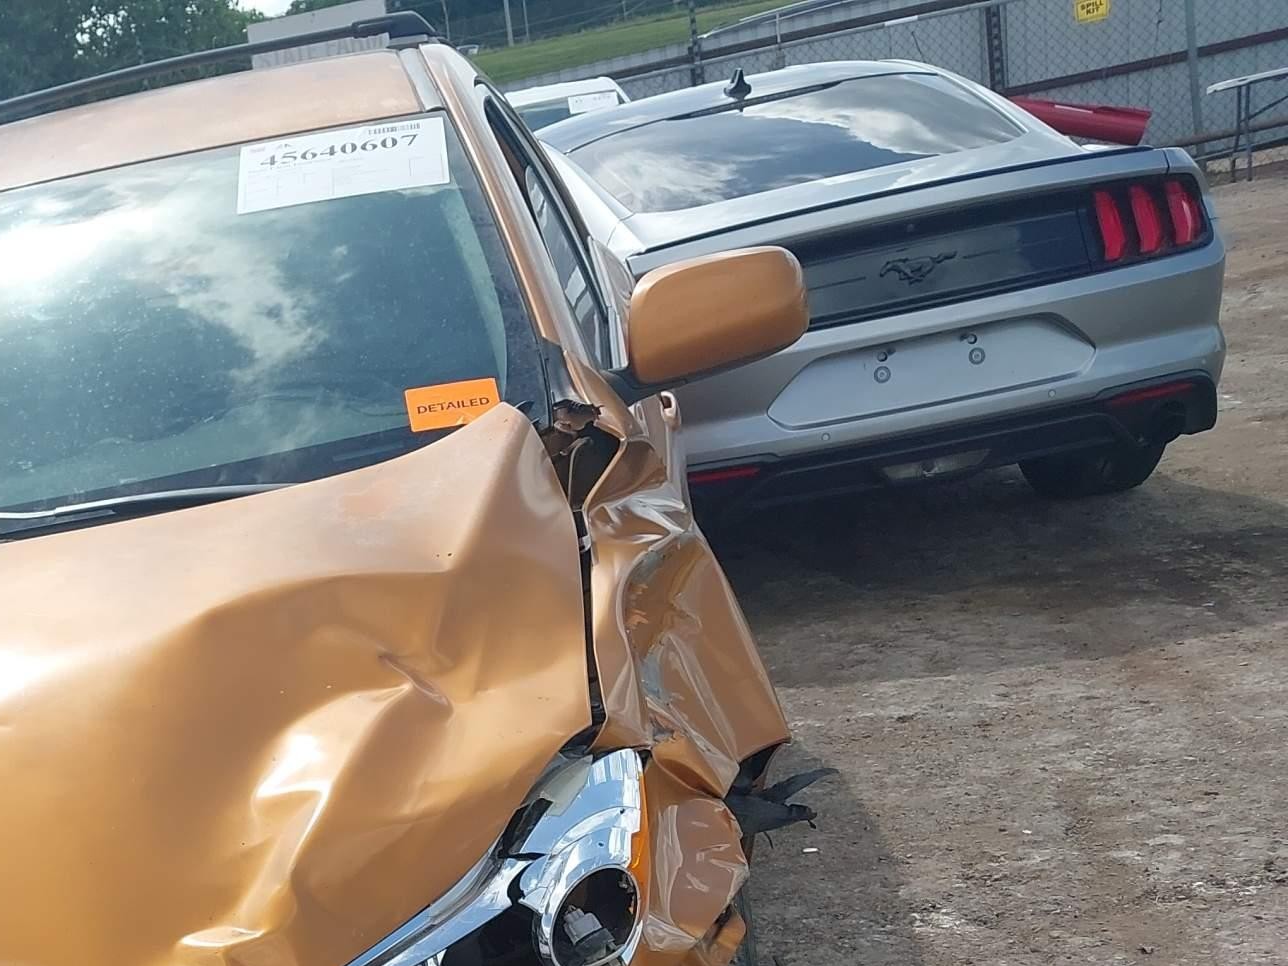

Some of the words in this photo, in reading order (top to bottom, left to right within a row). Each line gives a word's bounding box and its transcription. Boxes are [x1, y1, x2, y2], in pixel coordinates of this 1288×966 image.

[1080, 0, 1104, 11] SPILL
[1086, 6, 1101, 16] KIT
[259, 133, 419, 168] 45640607
[416, 397, 490, 415] DETAILED
